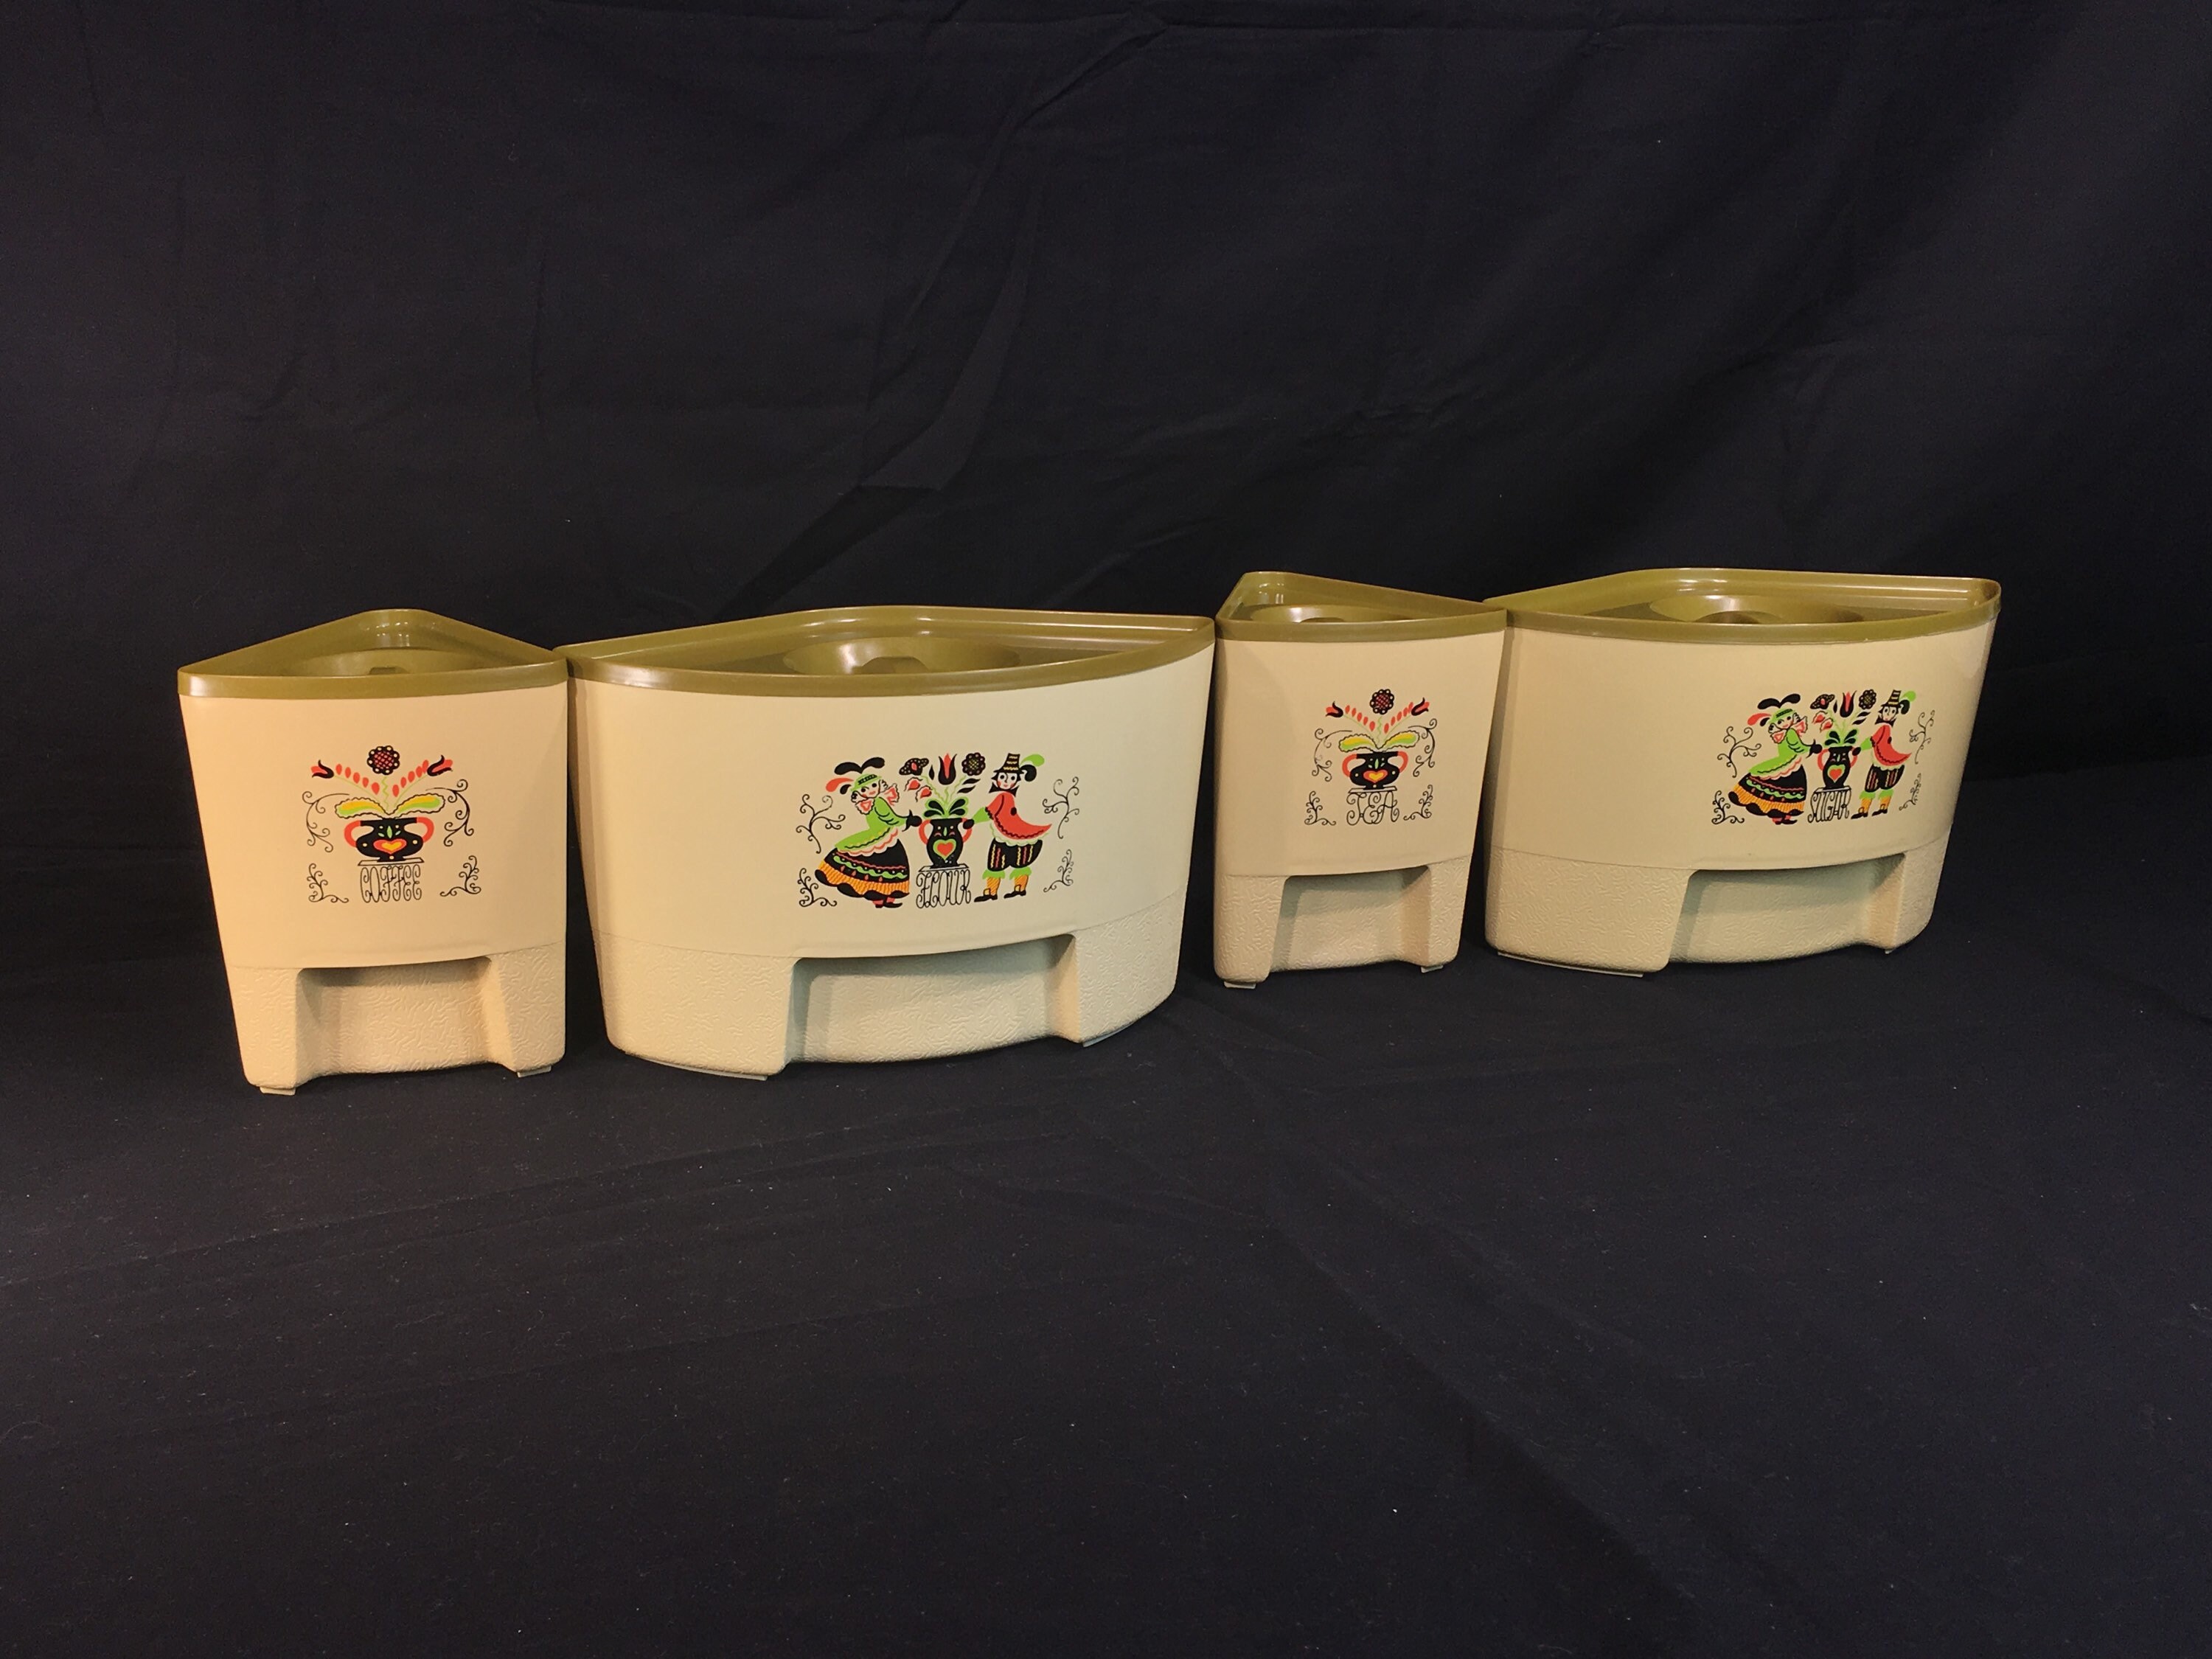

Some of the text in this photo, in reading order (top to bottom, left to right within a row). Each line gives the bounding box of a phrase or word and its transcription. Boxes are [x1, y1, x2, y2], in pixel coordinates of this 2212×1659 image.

[1346, 790, 1399, 826] TEA
[1807, 788, 1851, 823] SUGAR
[360, 864, 422, 903] COFFEE
[916, 869, 971, 908] FLOUR
